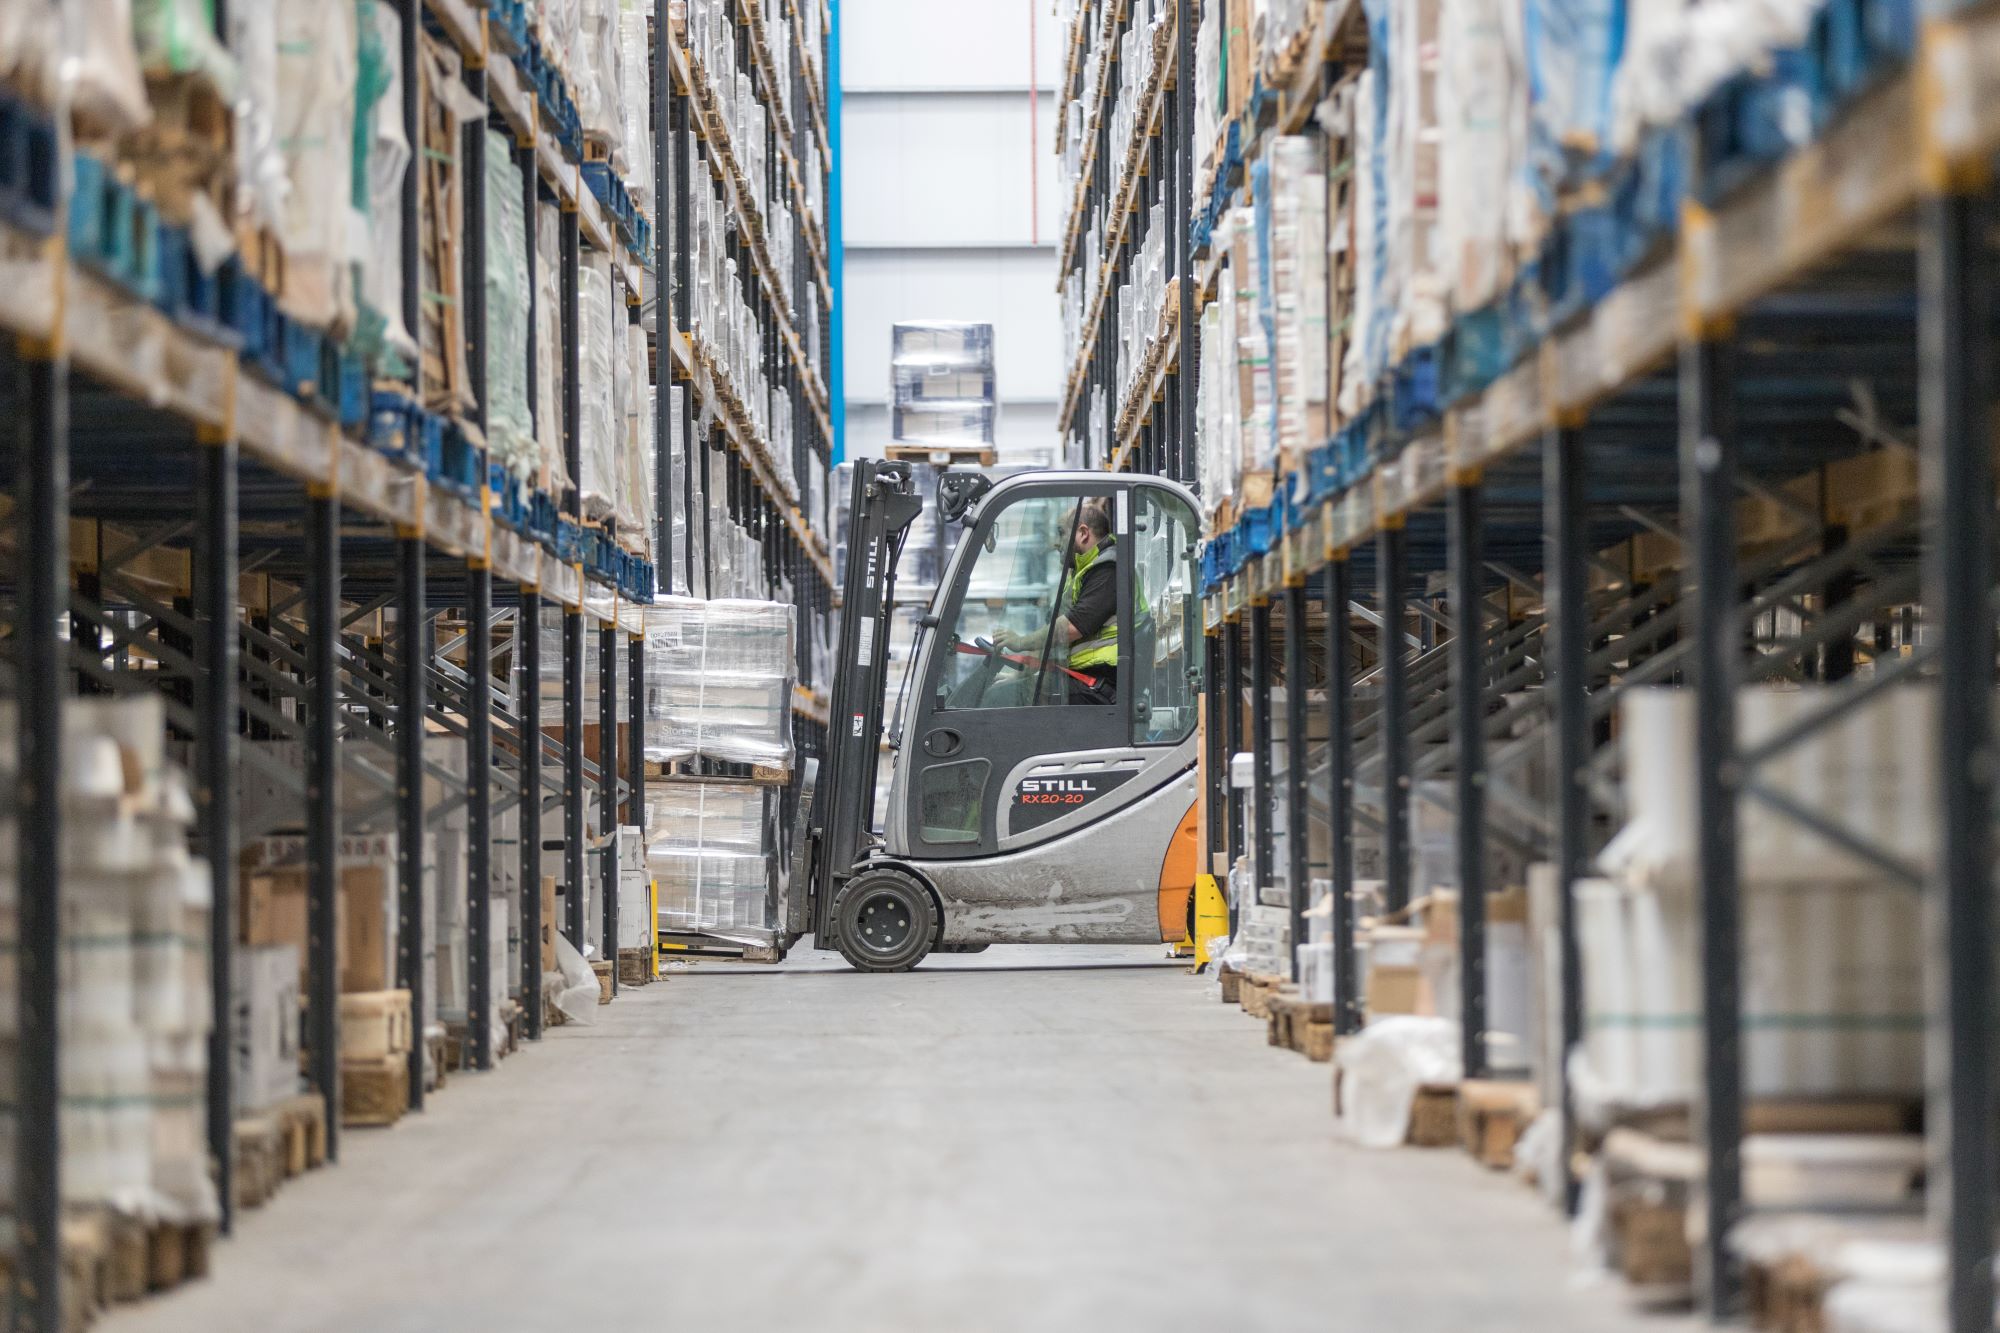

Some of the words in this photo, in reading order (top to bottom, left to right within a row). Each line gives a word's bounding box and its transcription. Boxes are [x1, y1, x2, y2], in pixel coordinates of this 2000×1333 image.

[866, 536, 878, 588] STILL
[1022, 780, 1096, 791] STILL
[1022, 794, 1084, 804] RX20-20
